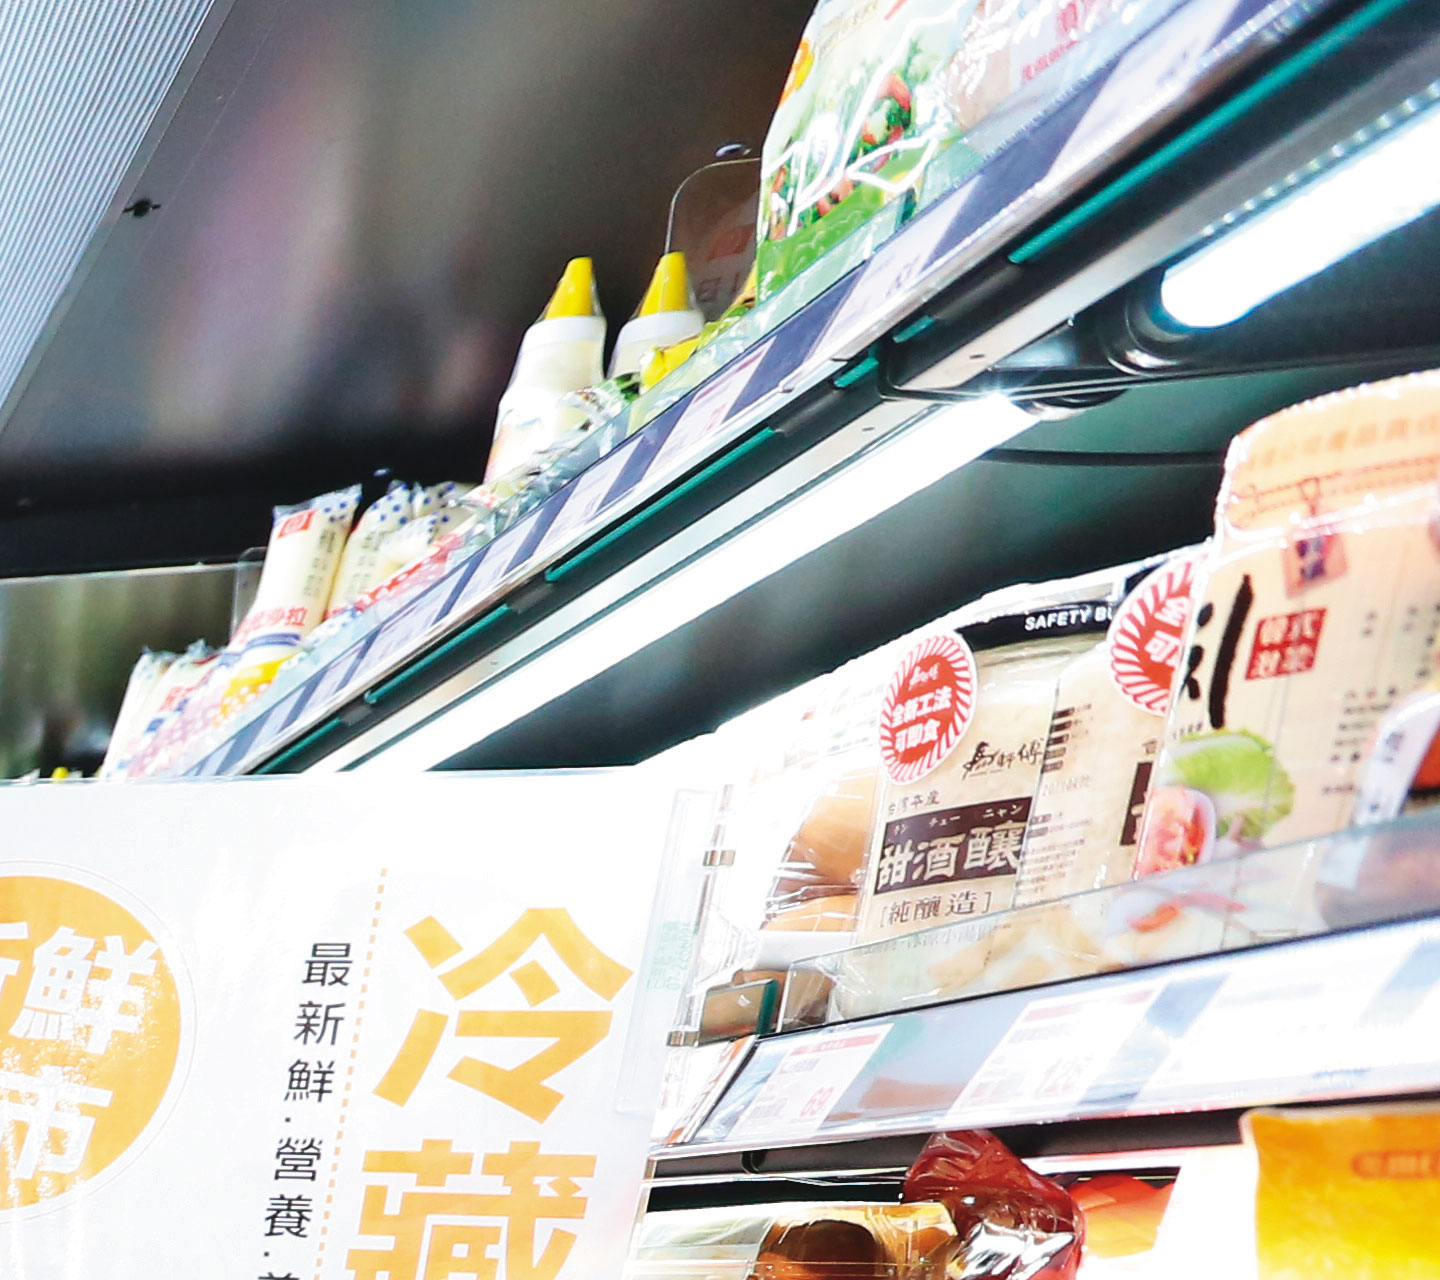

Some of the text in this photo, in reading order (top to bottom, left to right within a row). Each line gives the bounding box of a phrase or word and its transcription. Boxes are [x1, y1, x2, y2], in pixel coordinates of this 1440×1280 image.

[1024, 607, 1089, 631] SAFETY
[891, 686, 953, 727] 全新工法
[895, 721, 941, 752] 可即食
